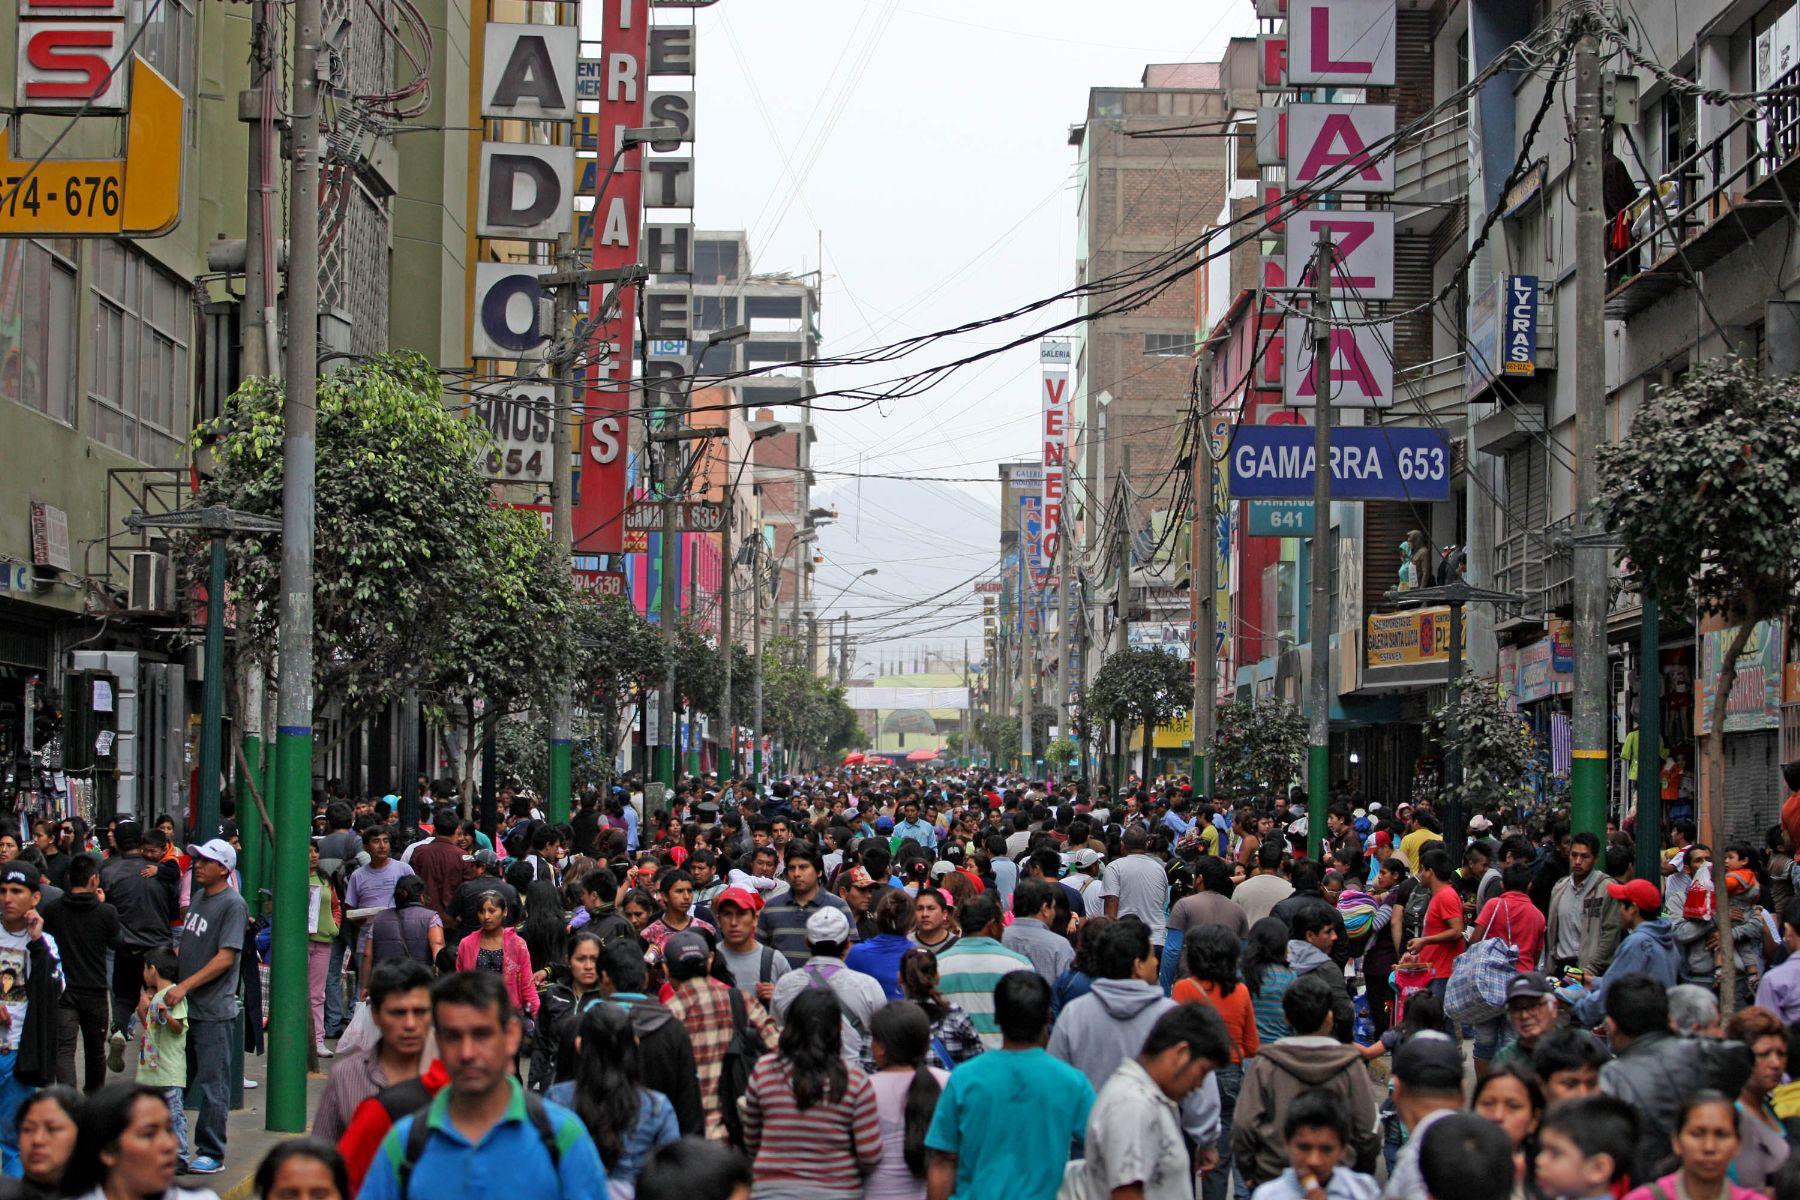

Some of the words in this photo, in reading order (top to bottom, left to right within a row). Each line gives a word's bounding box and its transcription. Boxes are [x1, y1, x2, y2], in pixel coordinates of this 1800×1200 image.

[0, 176, 41, 217] 74
[65, 176, 119, 217] 676
[1511, 277, 1532, 362] LYCRAS
[1041, 350, 1070, 358] GALERIA
[486, 449, 543, 476] 654
[1043, 379, 1066, 558] VENERO
[1235, 445, 1384, 480] GAMARRA
[1398, 447, 1445, 481] 653
[1270, 512, 1303, 528] 641
